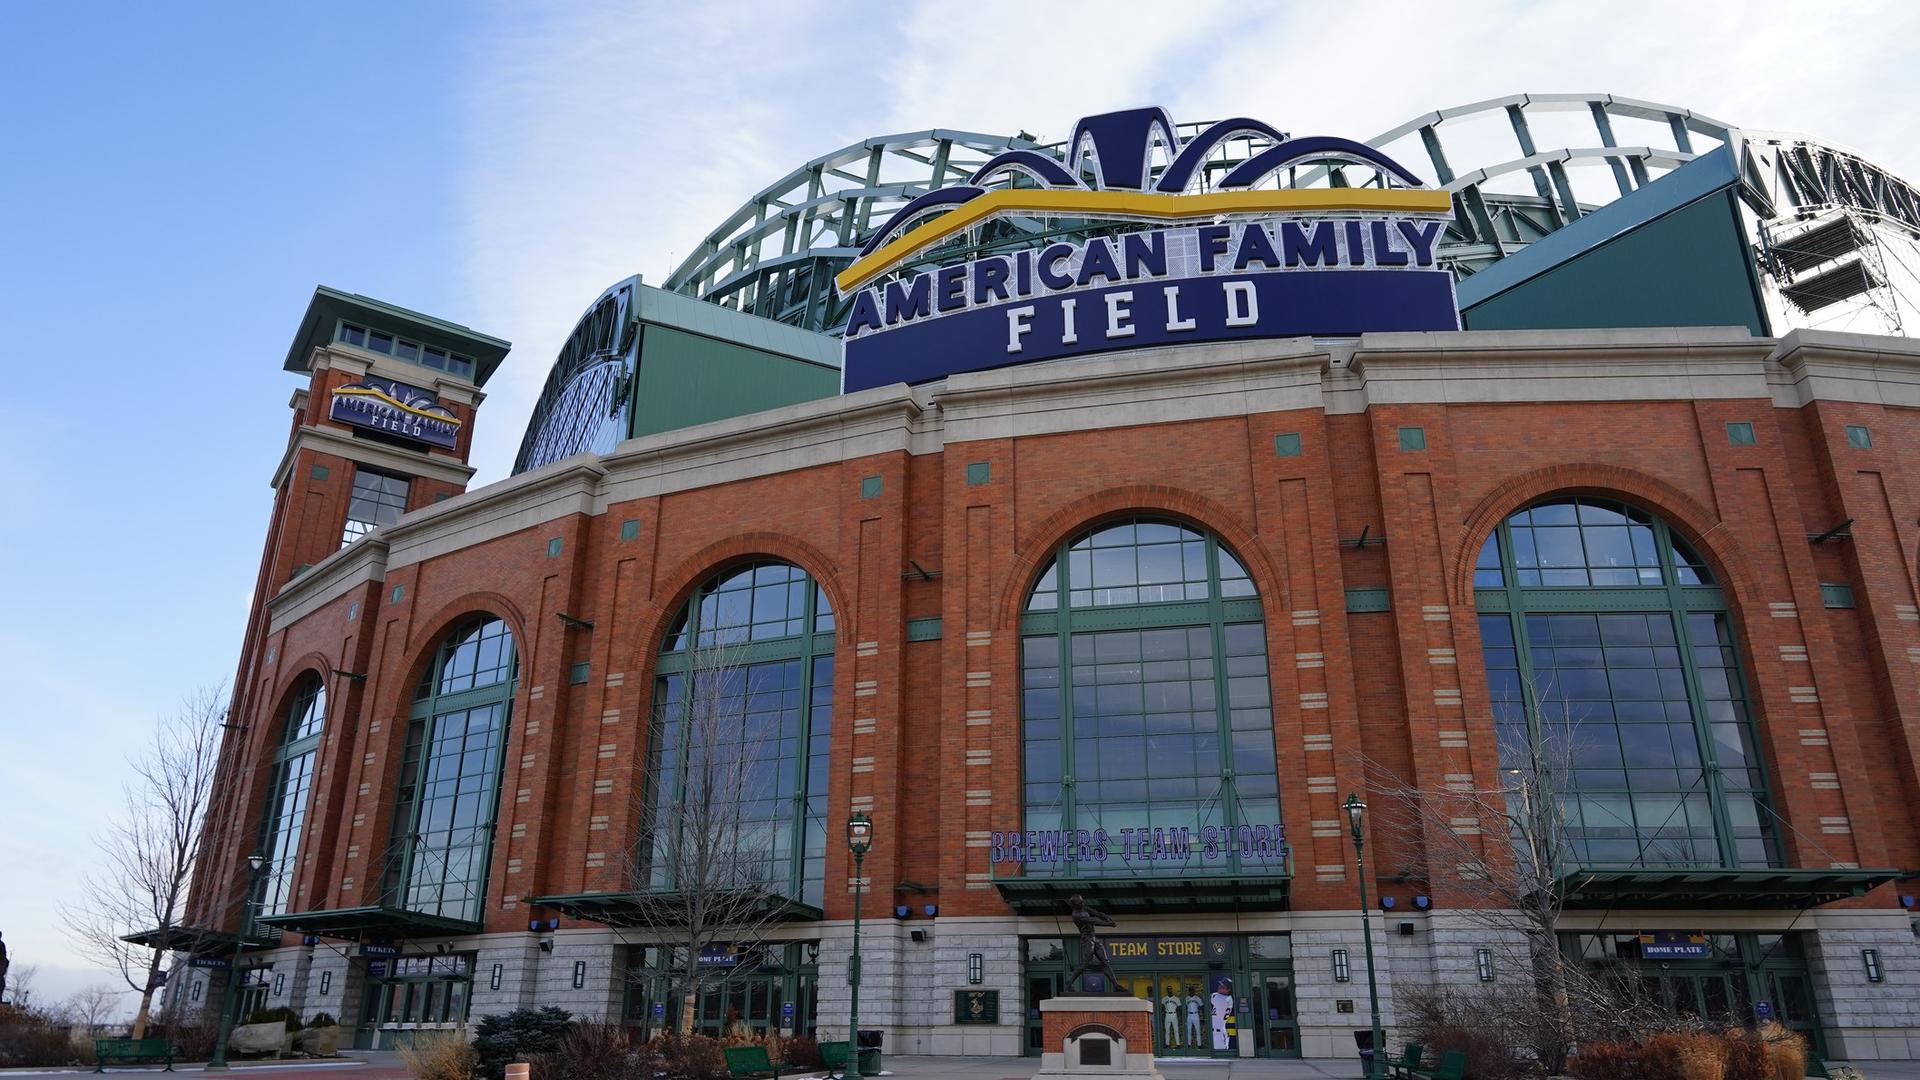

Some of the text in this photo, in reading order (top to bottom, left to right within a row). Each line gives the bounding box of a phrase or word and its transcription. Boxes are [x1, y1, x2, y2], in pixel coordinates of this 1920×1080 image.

[845, 220, 1441, 337] AMERICAN FAMILY
[1006, 280, 1259, 353] FIELD
[335, 395, 457, 435] AMERICAN FAMILY
[371, 415, 421, 436] FIELD
[991, 824, 1288, 863] BREWERS TEAM STORE
[366, 945, 396, 954] TICKETS
[1109, 941, 1202, 956] TEAM STORE
[1647, 945, 1703, 954] HOME PLATE
